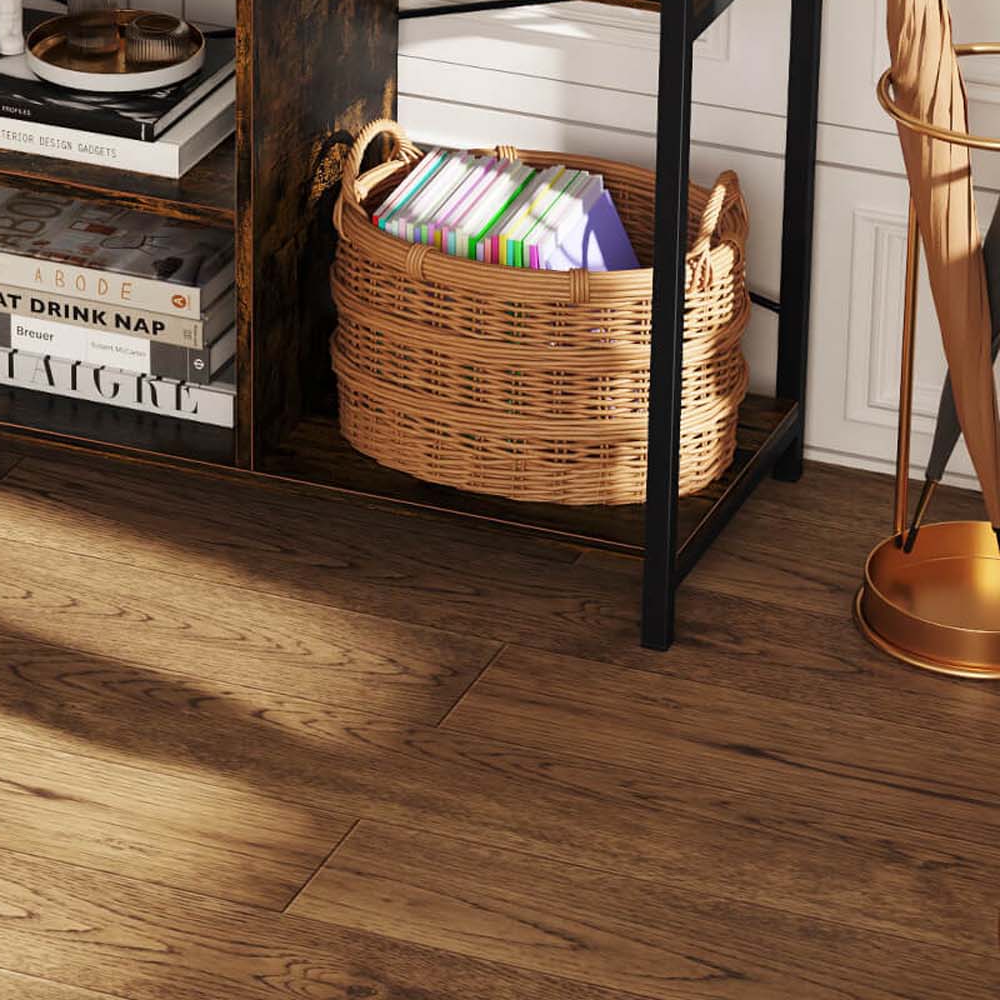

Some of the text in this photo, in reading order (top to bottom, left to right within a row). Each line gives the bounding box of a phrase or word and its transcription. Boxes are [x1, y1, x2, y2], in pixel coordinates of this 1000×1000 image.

[39, 134, 73, 151] DESIGN
[77, 142, 118, 159] GADGETS
[34, 266, 134, 301] ABODE
[30, 298, 107, 326] DRINK
[114, 313, 166, 337] NAP
[16, 325, 55, 342] Breuer
